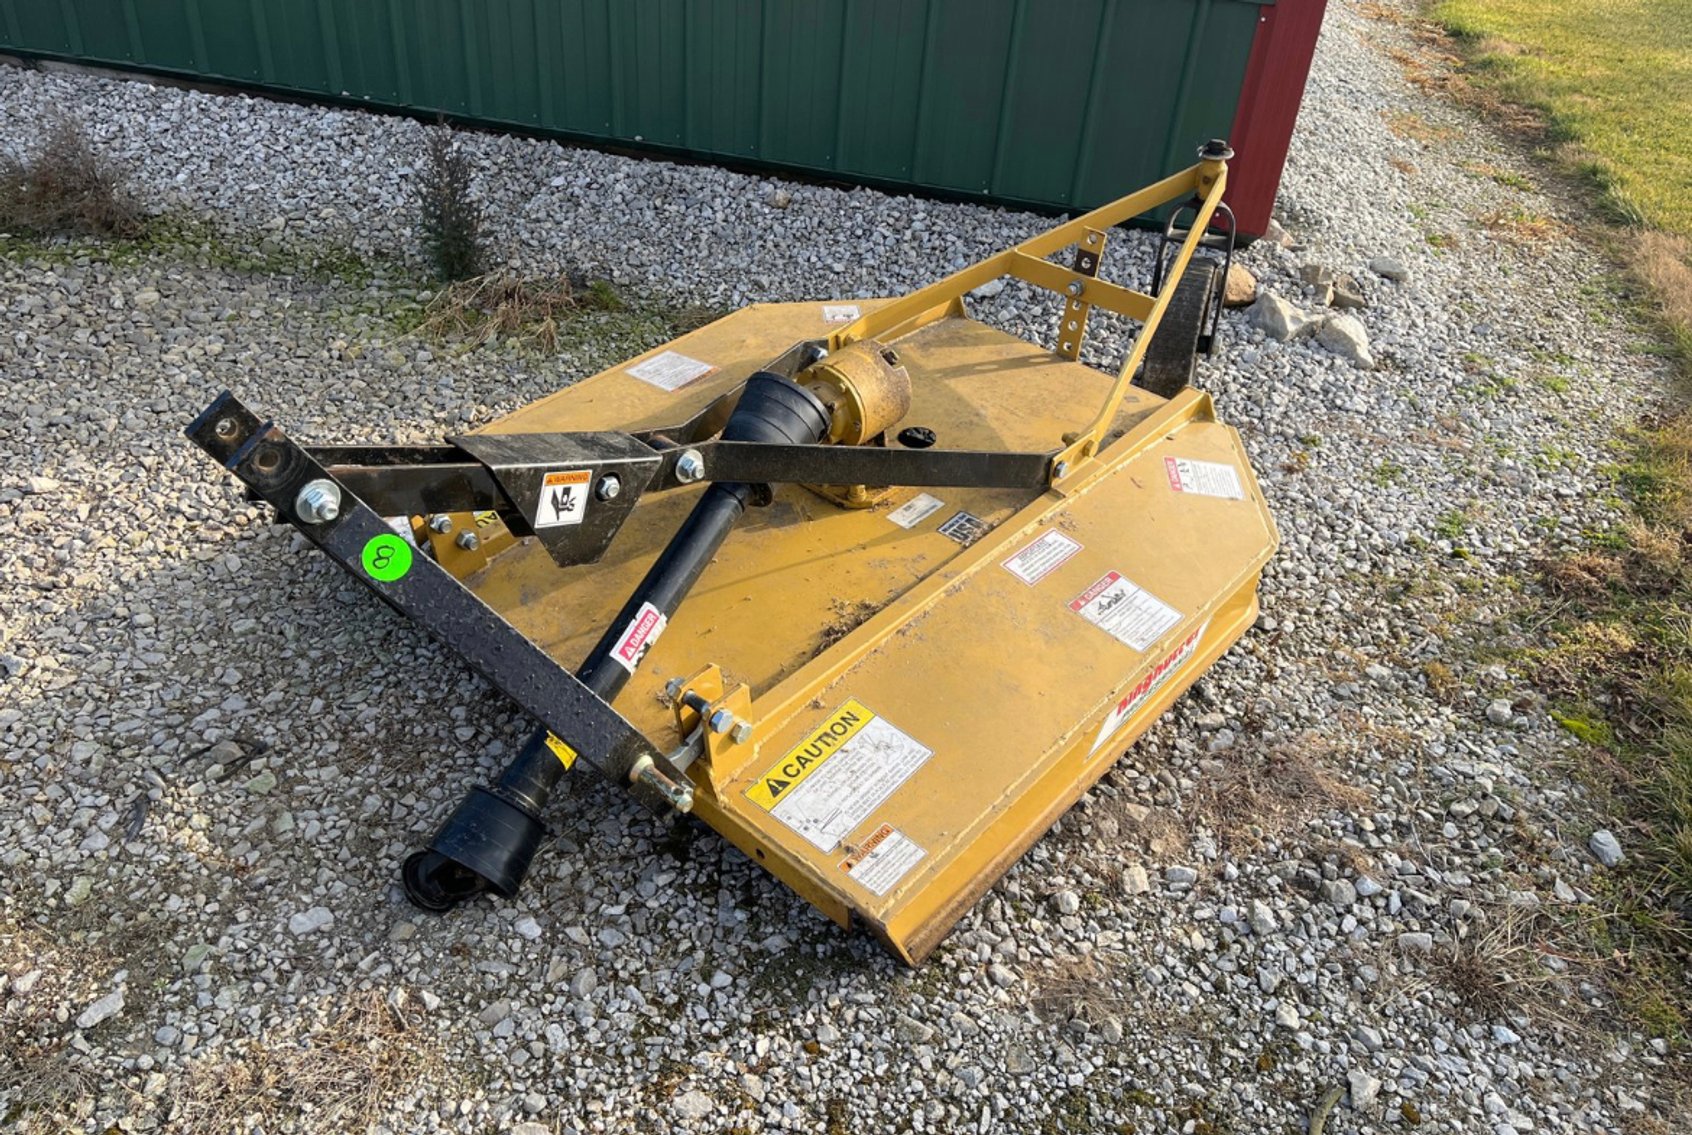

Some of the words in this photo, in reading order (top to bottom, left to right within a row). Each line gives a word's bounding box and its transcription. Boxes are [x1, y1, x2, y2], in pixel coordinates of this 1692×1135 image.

[555, 472, 589, 481] WARNING
[372, 545, 396, 570] 8
[1084, 576, 1113, 600] DANGER
[631, 613, 656, 648] DANGER
[782, 711, 861, 778] CAUTION
[851, 829, 890, 861] WARNING
